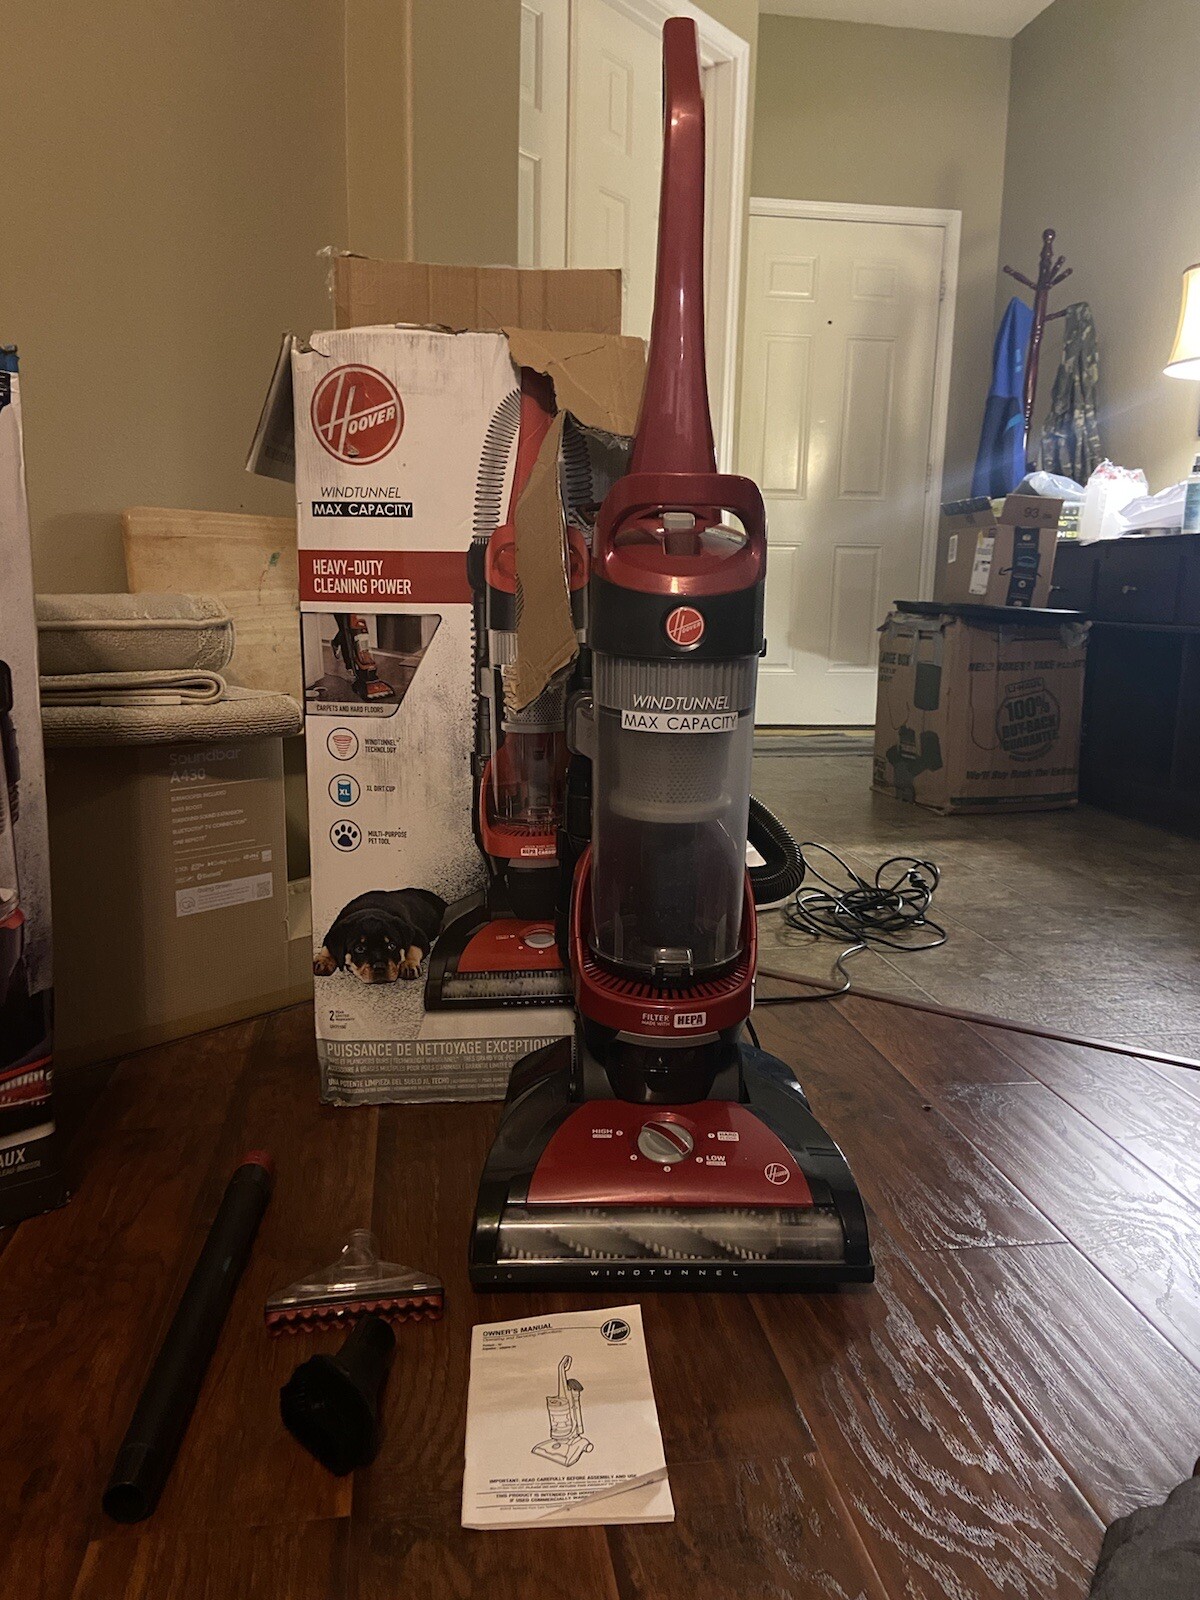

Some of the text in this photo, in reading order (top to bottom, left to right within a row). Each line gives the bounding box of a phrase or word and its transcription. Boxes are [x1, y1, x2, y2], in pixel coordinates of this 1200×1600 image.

[318, 371, 397, 456] HOOVER
[321, 487, 401, 498] WINDTUNNEL
[314, 504, 410, 515] MAX CAPACITY
[313, 560, 383, 575] HEAVY-DUTY
[314, 578, 411, 594] CLEANING POWER
[633, 694, 730, 711] WINDTUNNEL
[624, 714, 736, 730] MAX CAPACITY
[169, 748, 241, 766] Soundbar
[330, 1010, 334, 1021] 2
[642, 1013, 703, 1025] FILTER HEPA
[327, 1039, 558, 1057] PUISSANCE DE NETTOYAGE EXCEPTION
[483, 1323, 552, 1336] OWNER'S MANUAL
